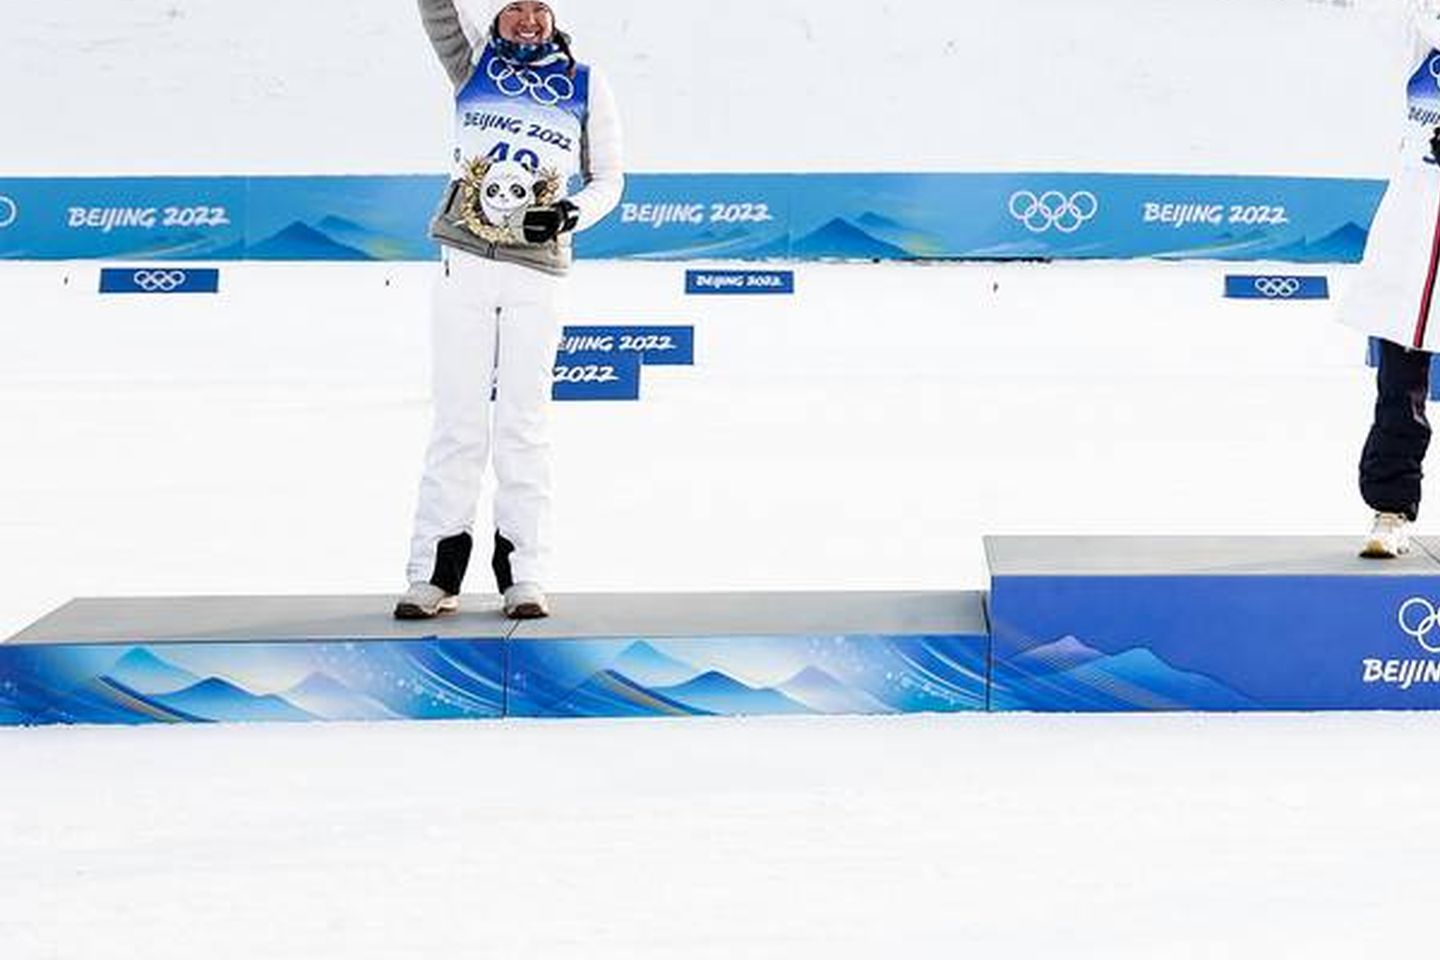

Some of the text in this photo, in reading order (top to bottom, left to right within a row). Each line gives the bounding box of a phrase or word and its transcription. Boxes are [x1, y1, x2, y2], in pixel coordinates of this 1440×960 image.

[464, 112, 572, 152] BEIJING 2022
[67, 206, 231, 233] BEIJING 2022
[621, 203, 773, 228] BEIJING 2022
[1143, 203, 1289, 228] BEIJING 2022
[696, 275, 784, 288] BEIJING 2022
[618, 335, 677, 351] 2022
[554, 365, 619, 382] 2022
